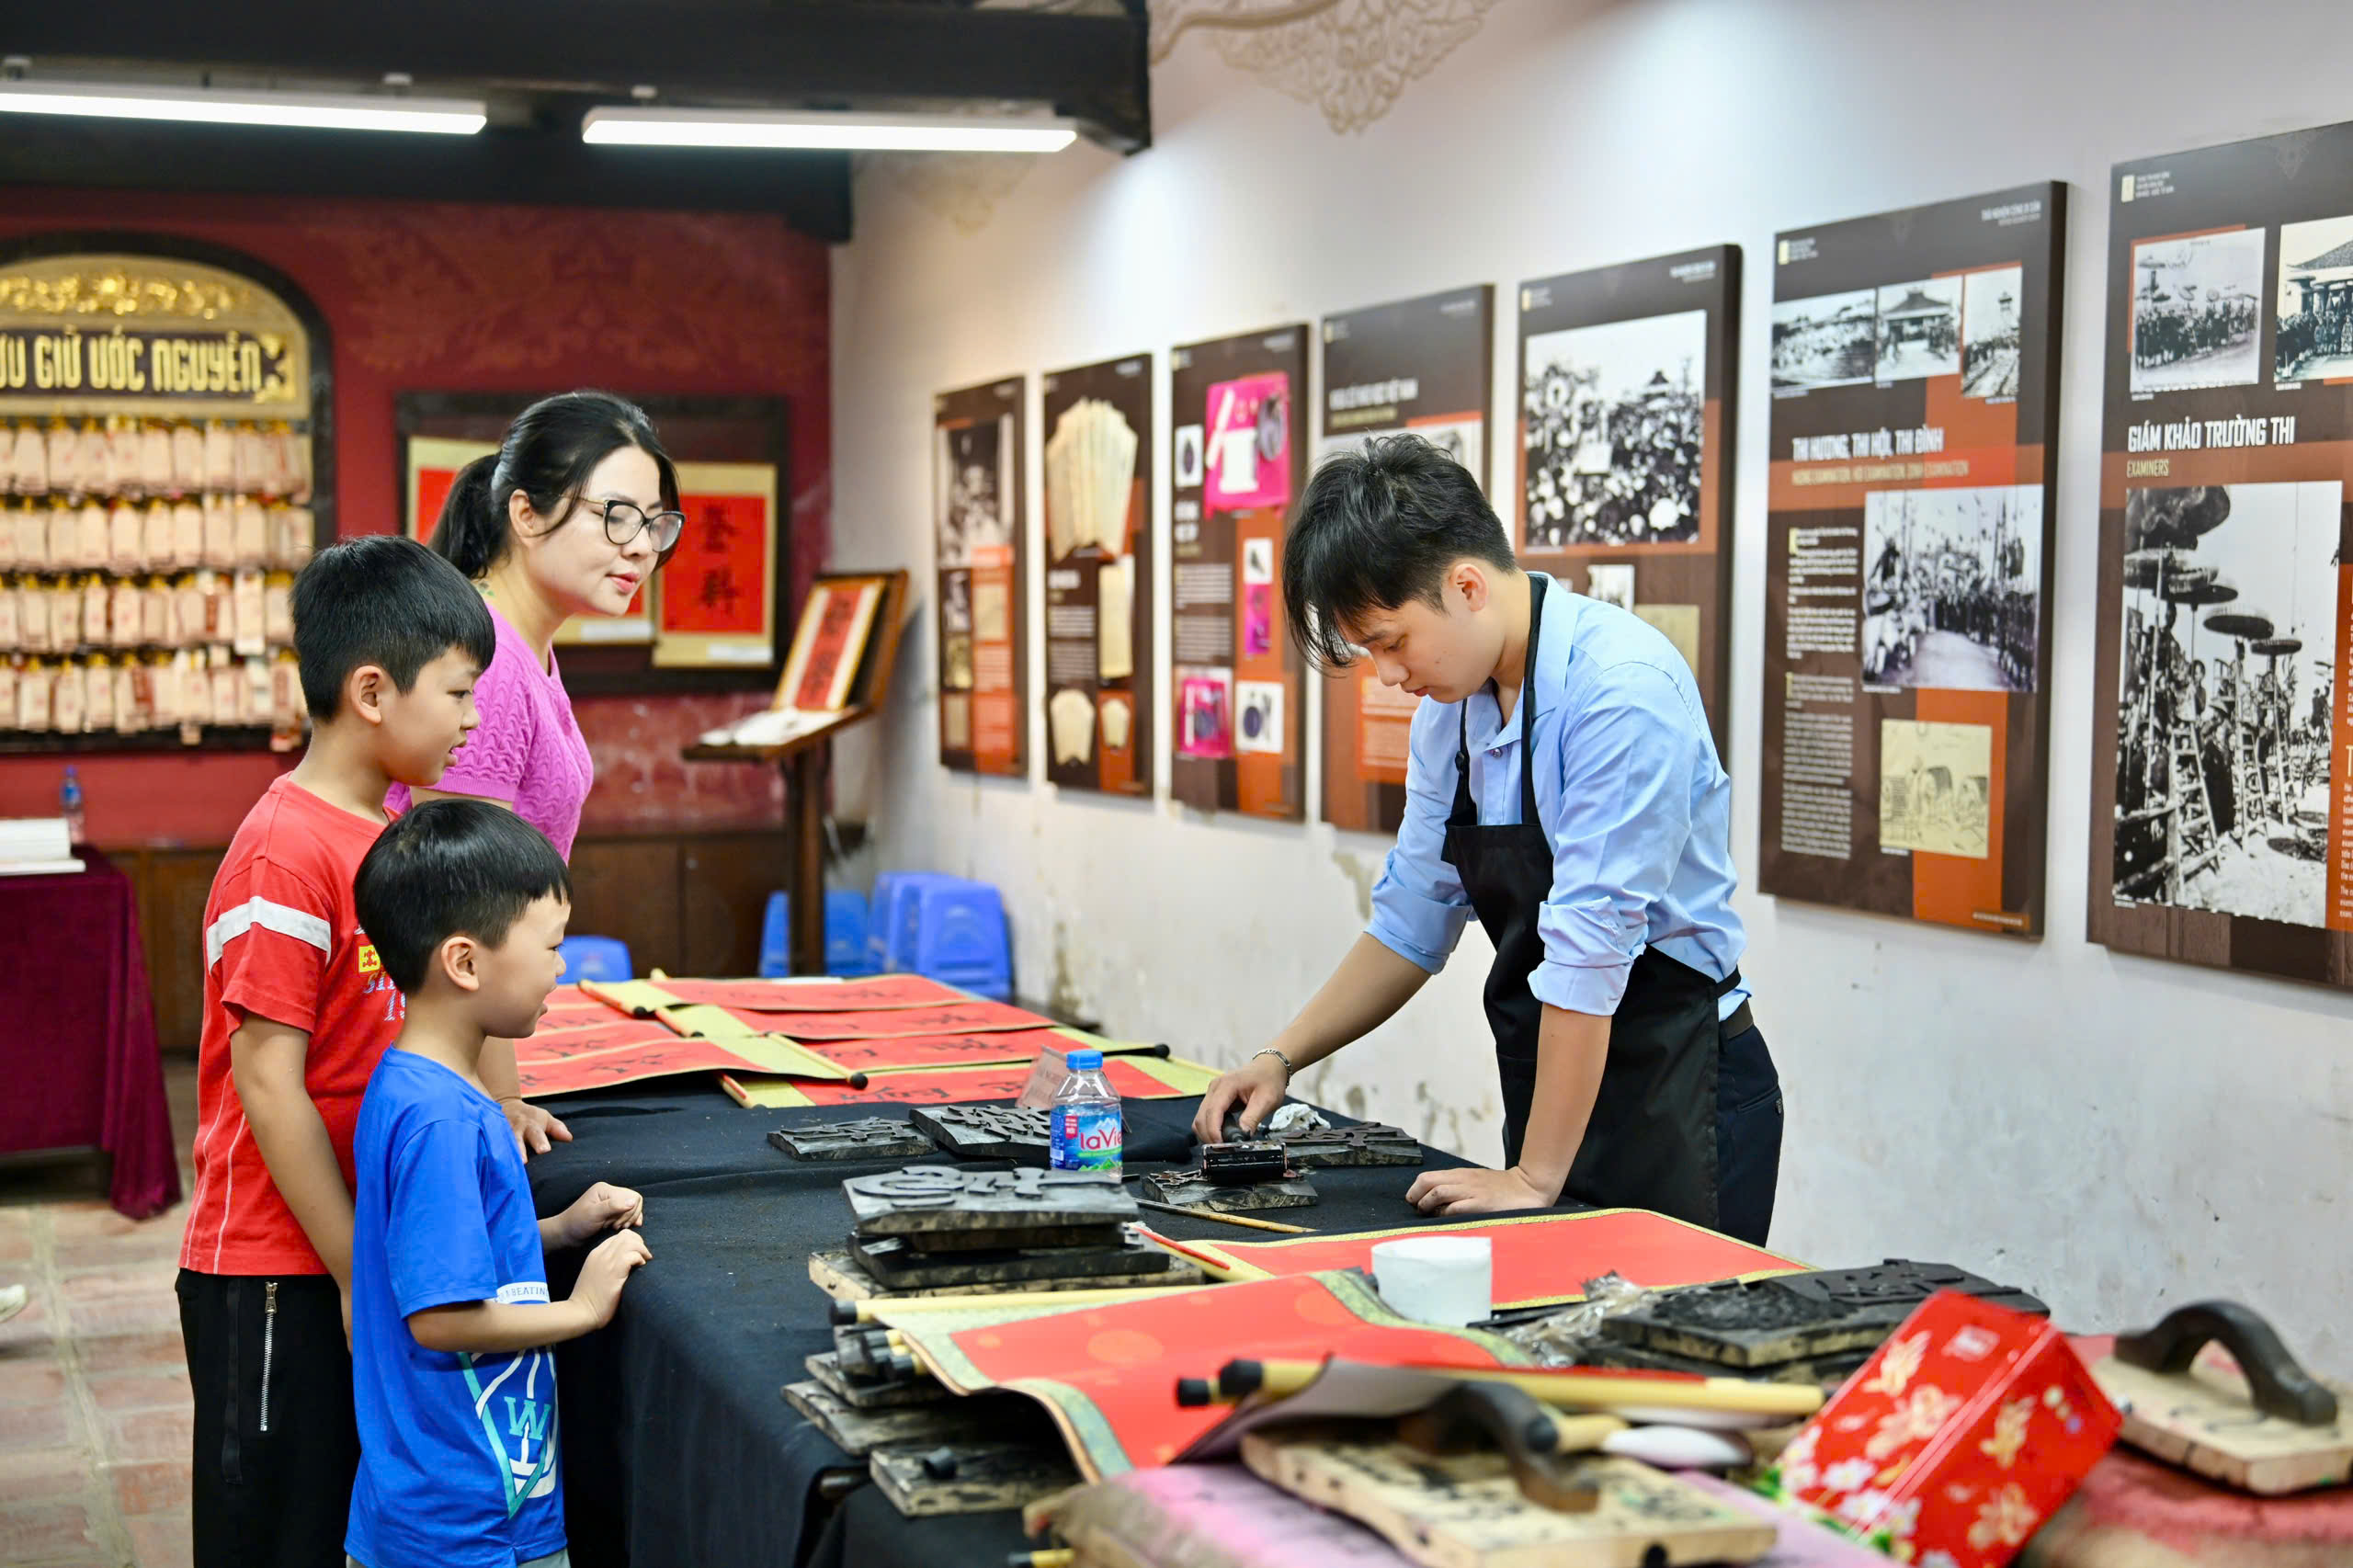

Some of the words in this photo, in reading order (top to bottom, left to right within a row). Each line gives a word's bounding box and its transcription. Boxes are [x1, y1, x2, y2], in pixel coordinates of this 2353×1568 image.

[2128, 420, 2161, 452] GIÁM
[2164, 415, 2201, 450] KHẢO
[2205, 414, 2267, 448] TRƯỜNG
[2270, 416, 2295, 444] THI
[2127, 459, 2169, 478] EXAMINERS
